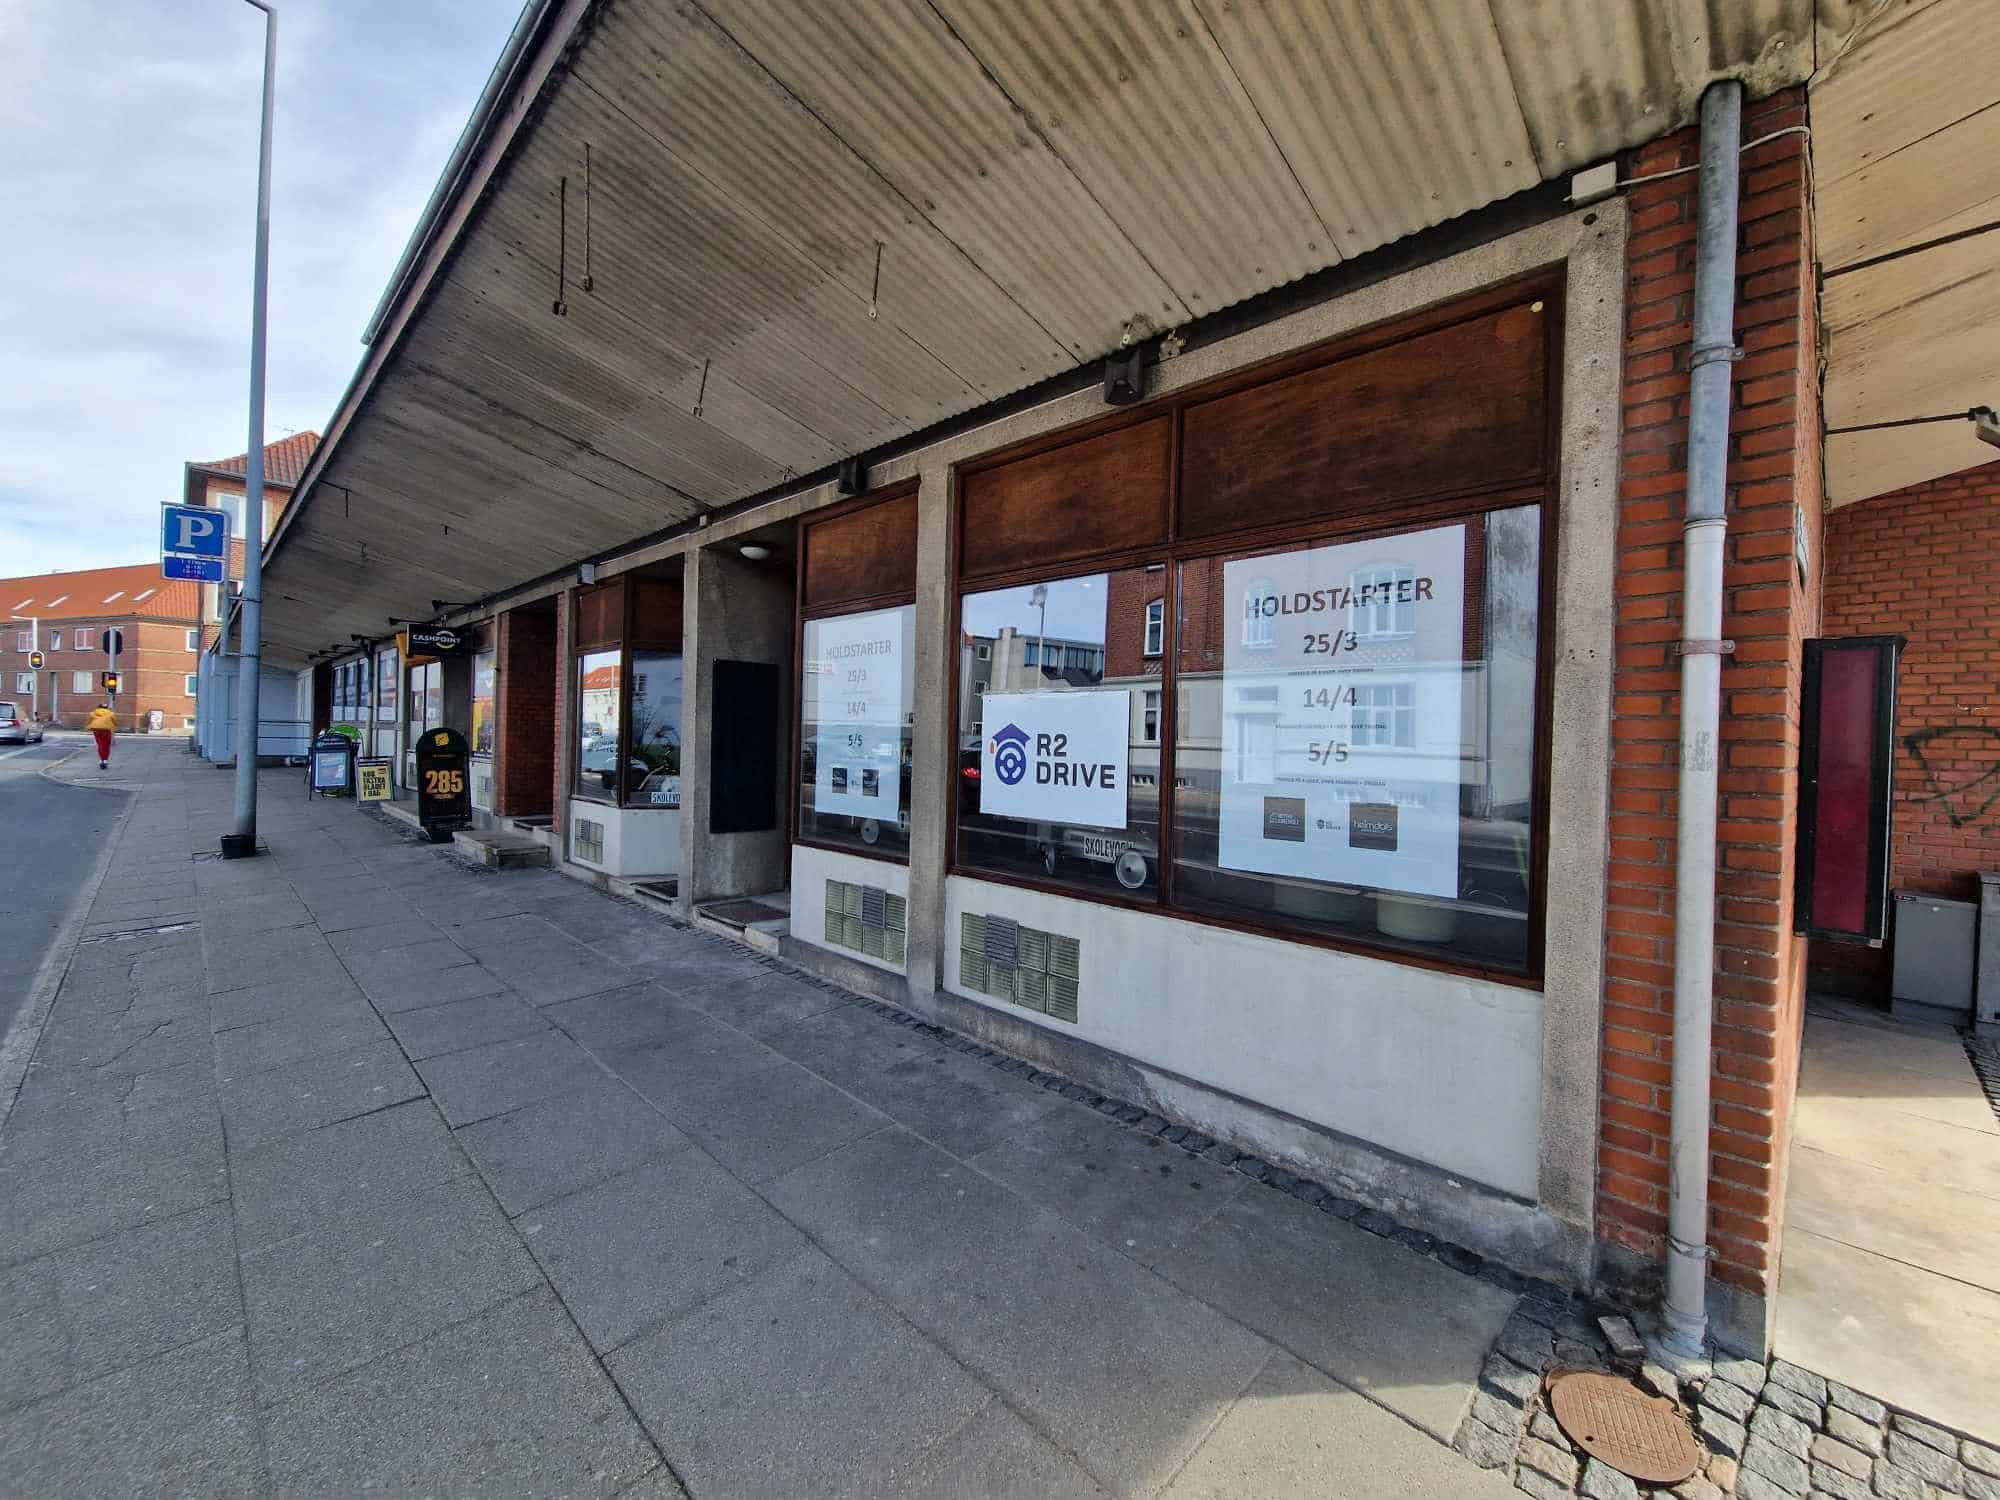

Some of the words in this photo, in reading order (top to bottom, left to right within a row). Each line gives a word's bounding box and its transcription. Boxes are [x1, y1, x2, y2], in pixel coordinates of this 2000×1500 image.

[175, 514, 214, 549] P
[1245, 577, 1434, 618] HOLDSTARTER
[412, 634, 461, 645] CASHPOINT
[825, 639, 892, 658] HOLDSTARTER
[1303, 629, 1358, 657] 25/3
[1303, 685, 1357, 711] 14/4
[847, 733, 864, 747] 5/5
[1036, 733, 1068, 757] R2
[1308, 740, 1349, 766] 5/5
[425, 770, 463, 794] 285
[1036, 761, 1116, 789] DRIVE
